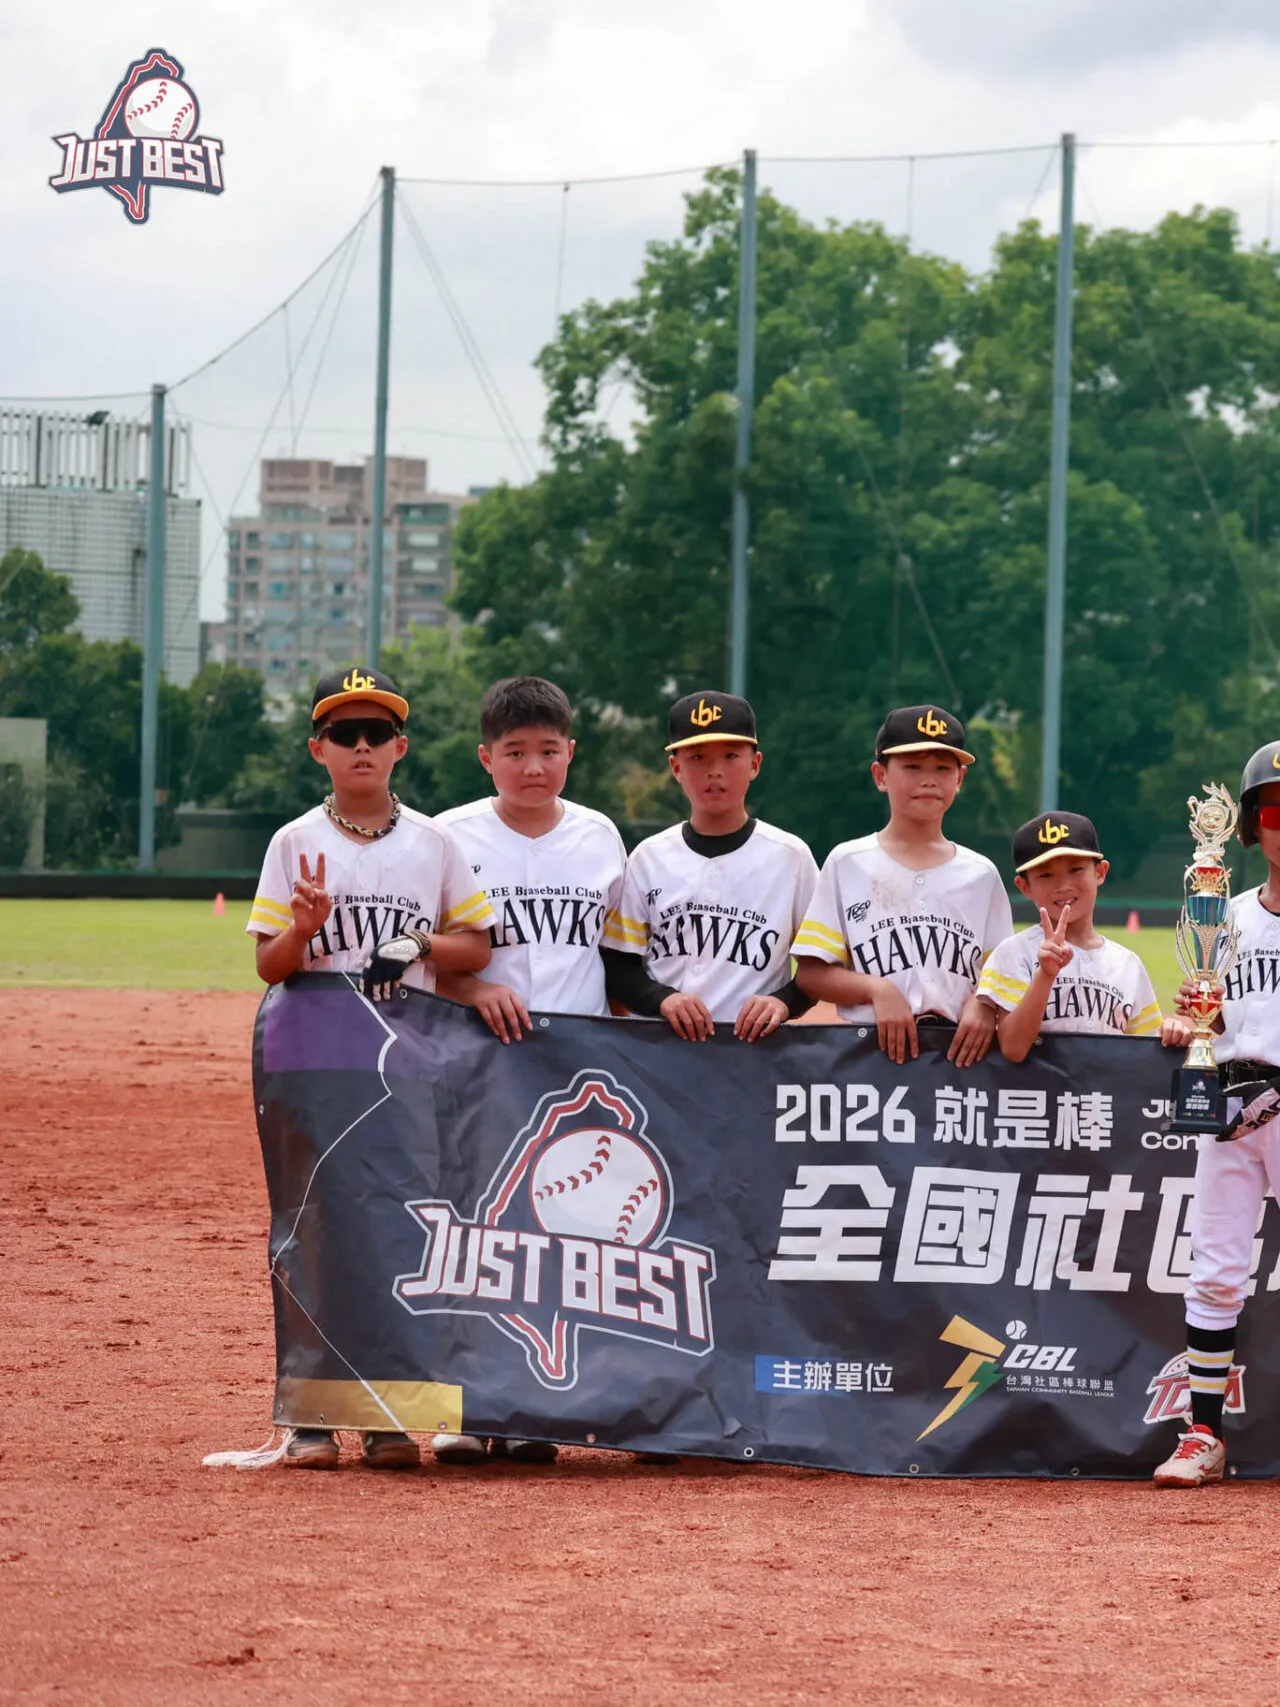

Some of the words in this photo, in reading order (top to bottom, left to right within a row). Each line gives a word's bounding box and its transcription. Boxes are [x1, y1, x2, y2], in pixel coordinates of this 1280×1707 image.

[345, 894, 393, 905] Baseball
[397, 896, 421, 911] Club
[515, 886, 570, 896] Baseball
[575, 887, 602, 900] Club
[686, 901, 738, 917] Baseball
[743, 909, 767, 924] Club
[871, 917, 895, 934] LEE
[900, 914, 951, 927] Baseball
[953, 921, 975, 939] Club
[853, 925, 982, 986] HAWKS
[1056, 977, 1076, 985] LEE
[775, 1084, 916, 1143] 2026
[934, 1086, 1114, 1152] 就是棒
[400, 1205, 550, 1304] JUST
[560, 1238, 708, 1341] BEST
[772, 1360, 894, 1393] 主辦單位
[1006, 1374, 1115, 1391] 台灣社區棒球聯盟
